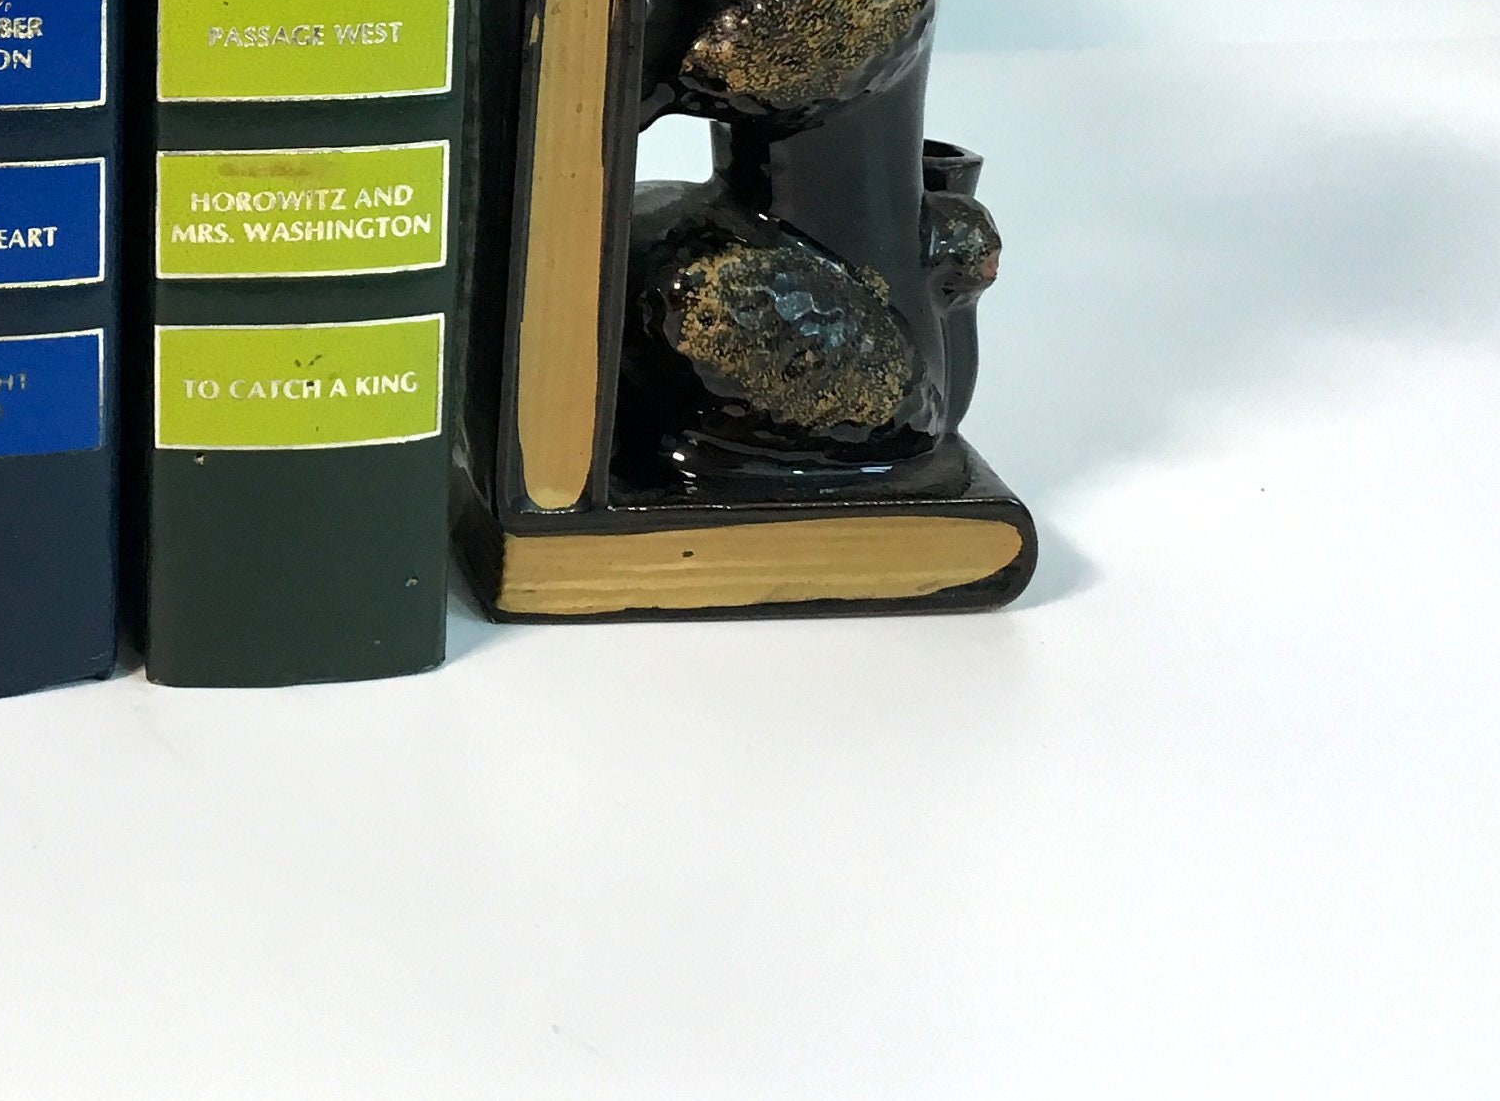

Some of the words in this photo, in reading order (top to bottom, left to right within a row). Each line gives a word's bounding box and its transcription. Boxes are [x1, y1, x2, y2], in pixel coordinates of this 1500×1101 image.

[208, 24, 324, 47] PASSAGE
[334, 22, 403, 44] WEST
[191, 189, 346, 212] HOROWITZ
[355, 184, 413, 209] AND
[171, 224, 234, 243] MRS.
[243, 214, 431, 242] WASHINGTON
[184, 379, 220, 399] TO
[229, 378, 320, 399] CATCH
[330, 378, 348, 397] A
[356, 371, 418, 396] KING
